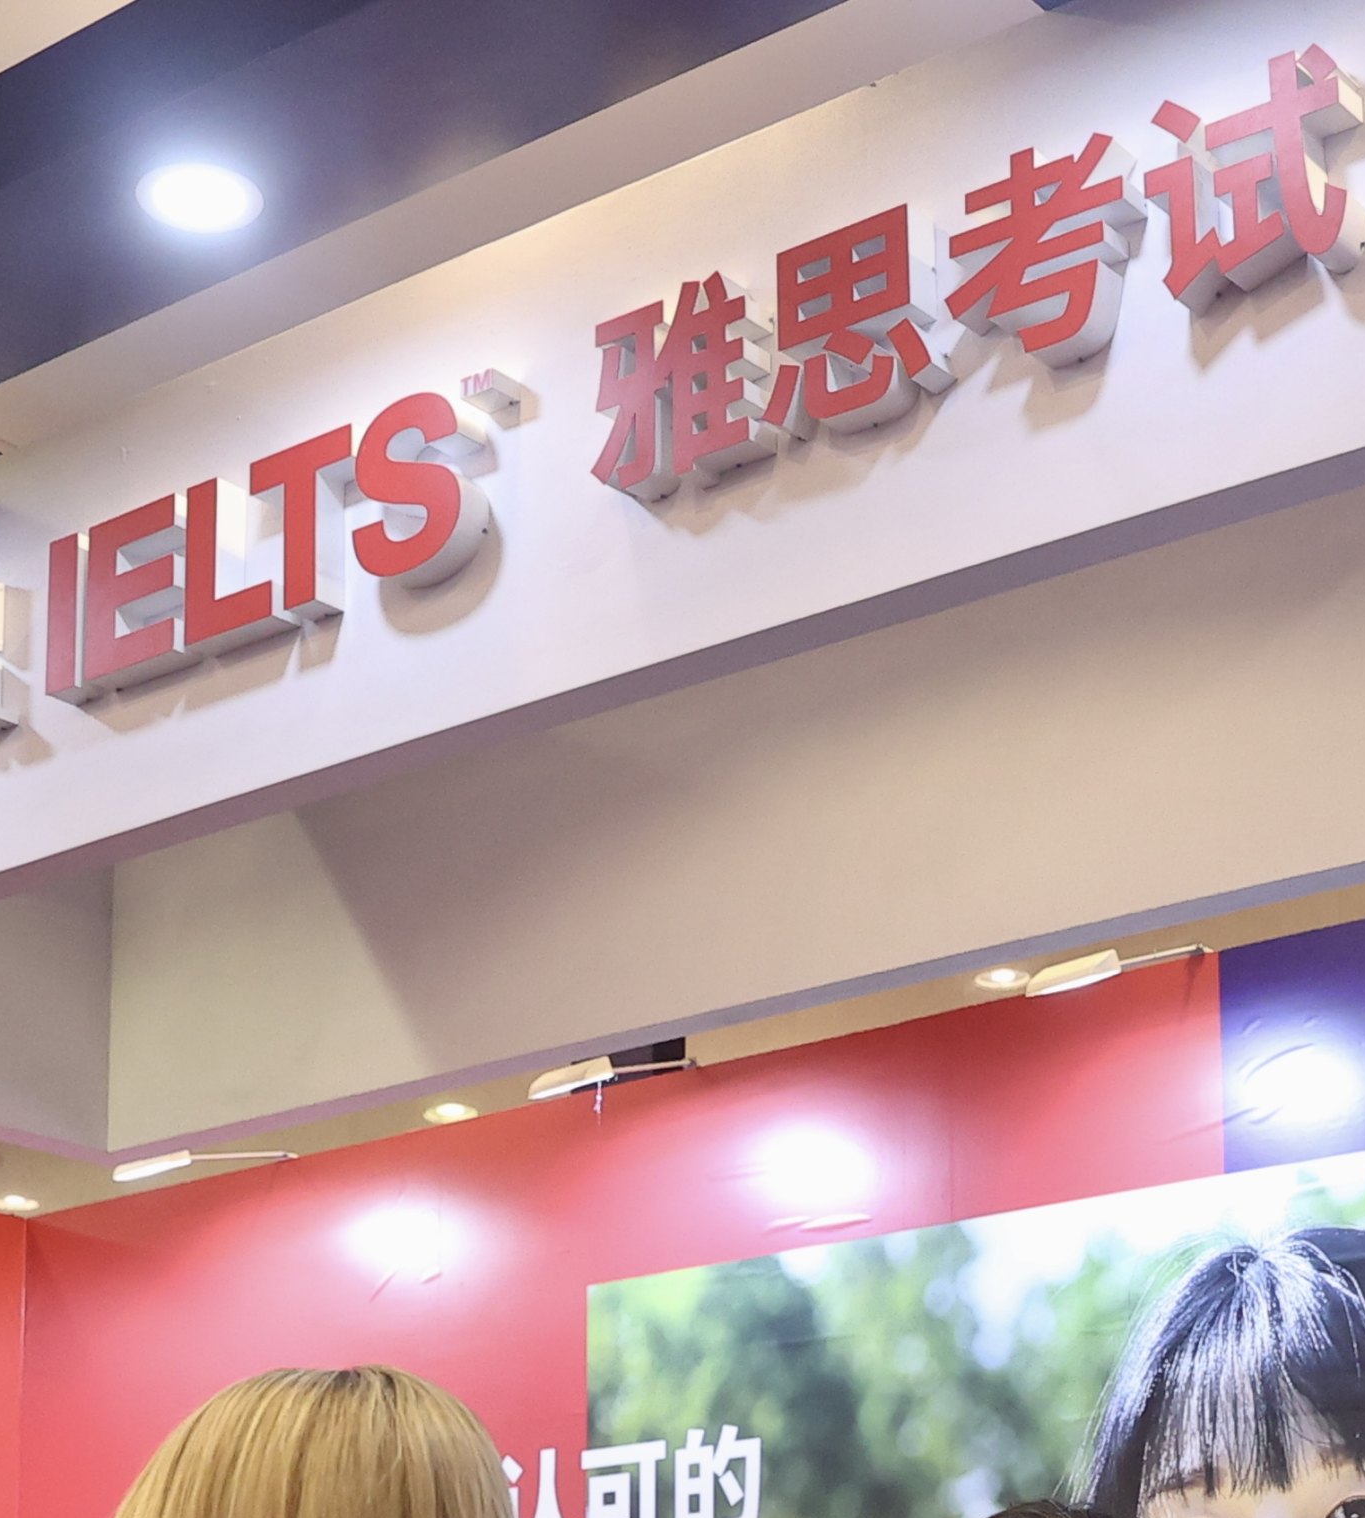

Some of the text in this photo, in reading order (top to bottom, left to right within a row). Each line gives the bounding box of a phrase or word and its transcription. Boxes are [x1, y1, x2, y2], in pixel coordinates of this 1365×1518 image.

[591, 43, 1350, 488] 雅思考试
[45, 391, 463, 698] IELTS
